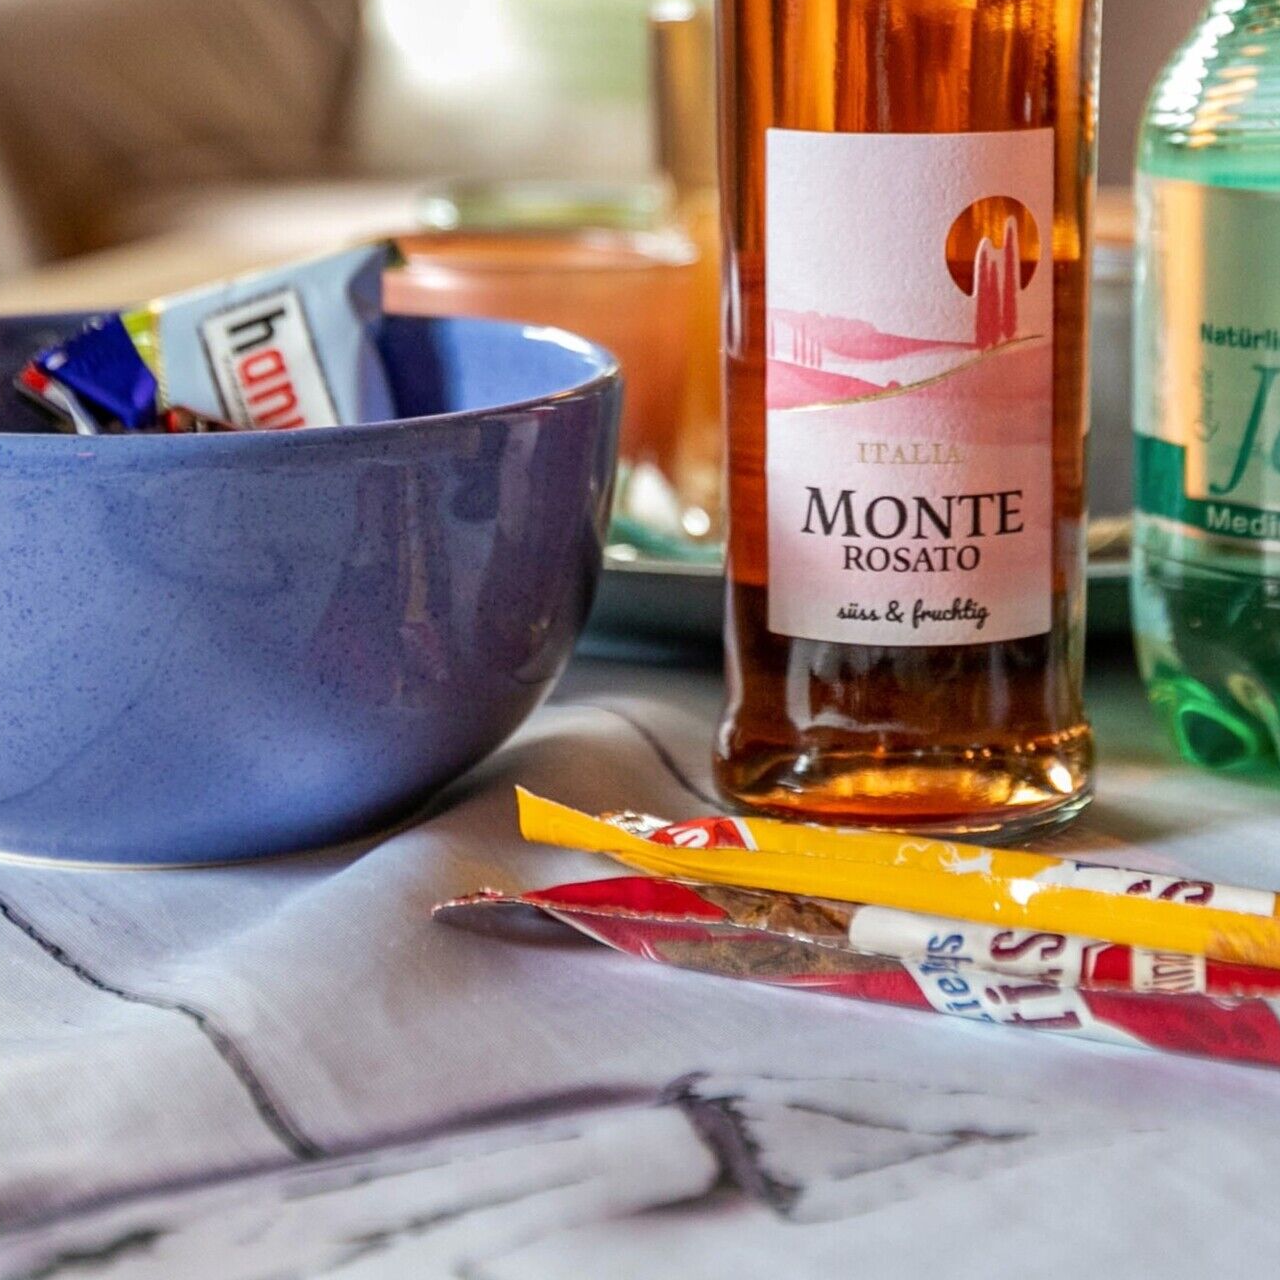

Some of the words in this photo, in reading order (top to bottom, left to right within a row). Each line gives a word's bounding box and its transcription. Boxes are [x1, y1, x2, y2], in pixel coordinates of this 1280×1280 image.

[858, 442, 964, 464] ITALIA
[800, 486, 1025, 540] MONTE
[842, 545, 981, 572] ROSATO
[837, 603, 880, 620] süss
[885, 600, 904, 622] &
[912, 597, 989, 629] fruchtig
